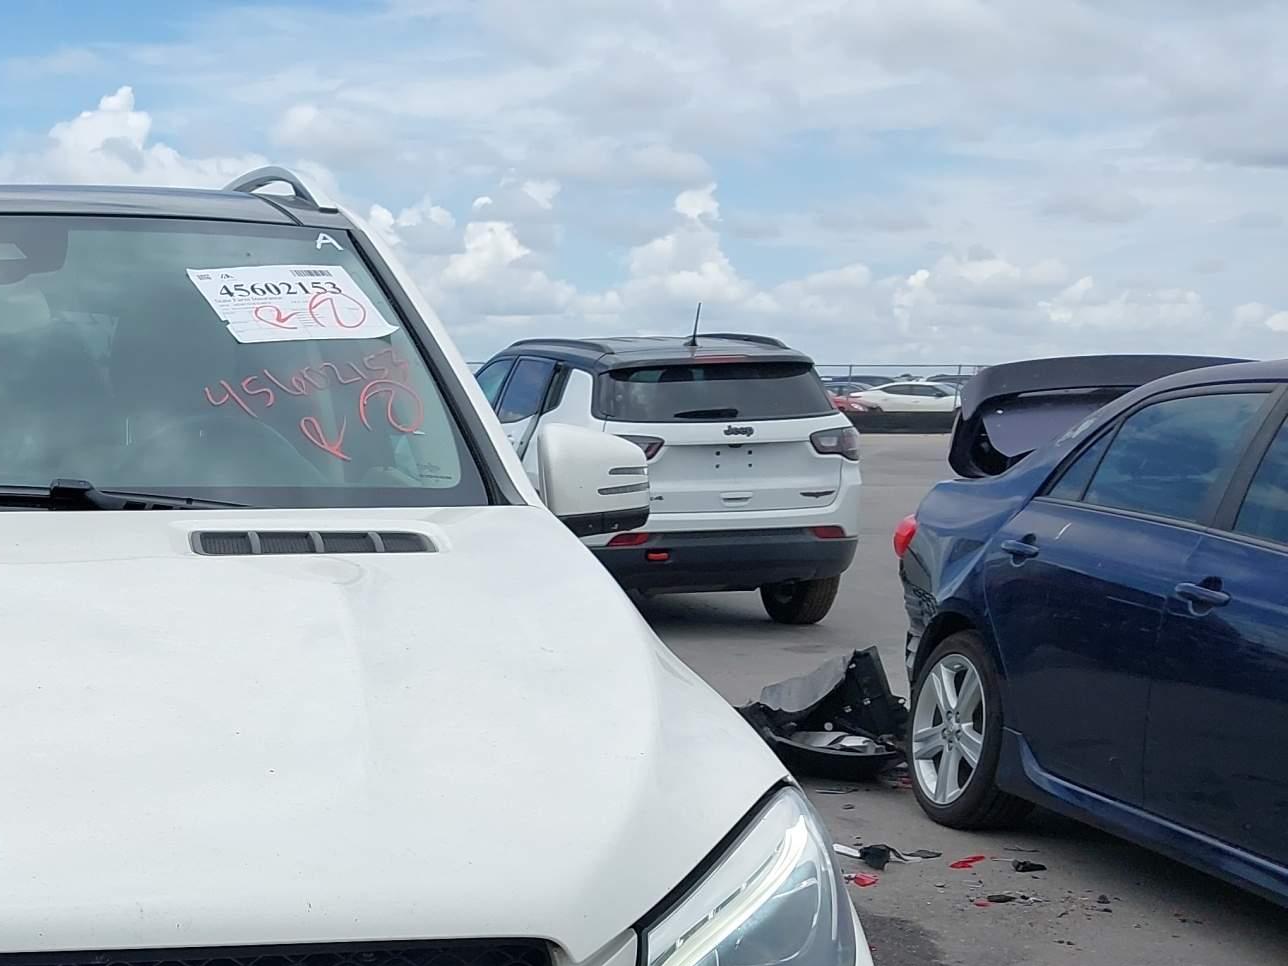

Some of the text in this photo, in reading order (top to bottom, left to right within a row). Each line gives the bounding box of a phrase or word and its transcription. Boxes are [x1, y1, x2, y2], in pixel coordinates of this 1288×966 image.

[316, 233, 344, 250] A
[219, 281, 343, 298] 45602153
[204, 347, 410, 418] 45602153
[723, 425, 754, 437] Jeep
